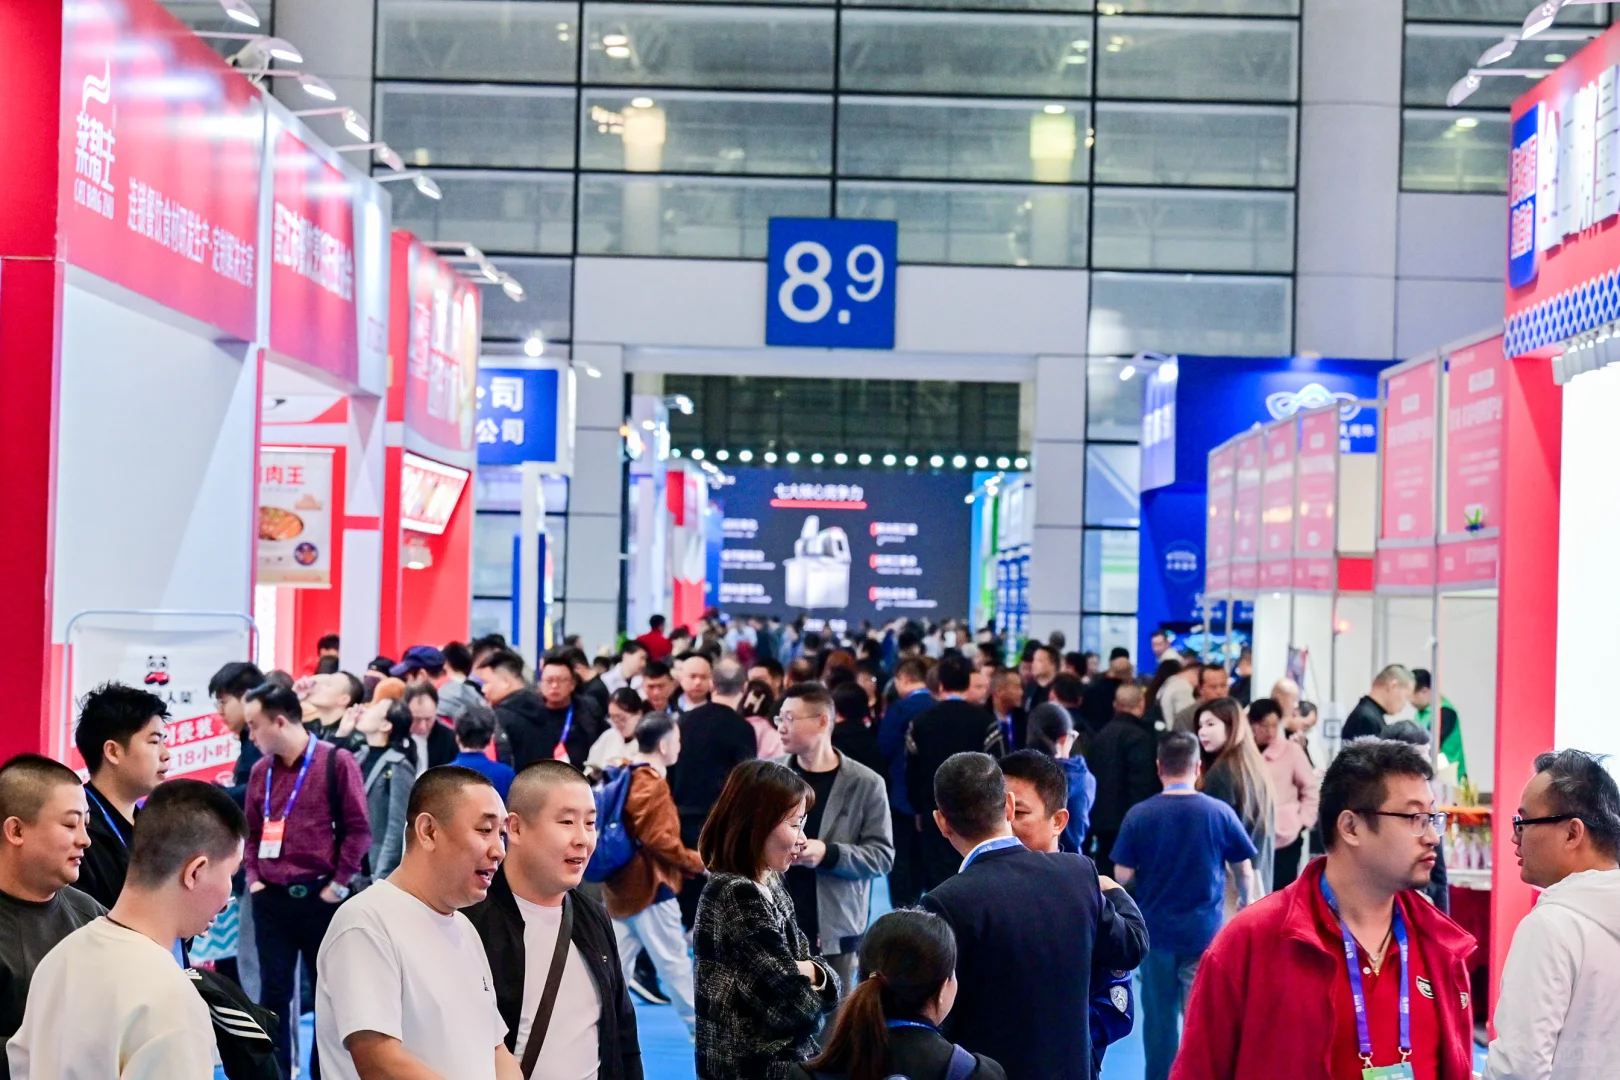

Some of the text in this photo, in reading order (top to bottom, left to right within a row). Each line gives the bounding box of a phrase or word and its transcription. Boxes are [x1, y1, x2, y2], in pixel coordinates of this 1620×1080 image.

[778, 241, 884, 323] 8.9
[476, 417, 524, 446] 公司
[260, 464, 305, 485] 肉王
[169, 739, 232, 771] 18小时
